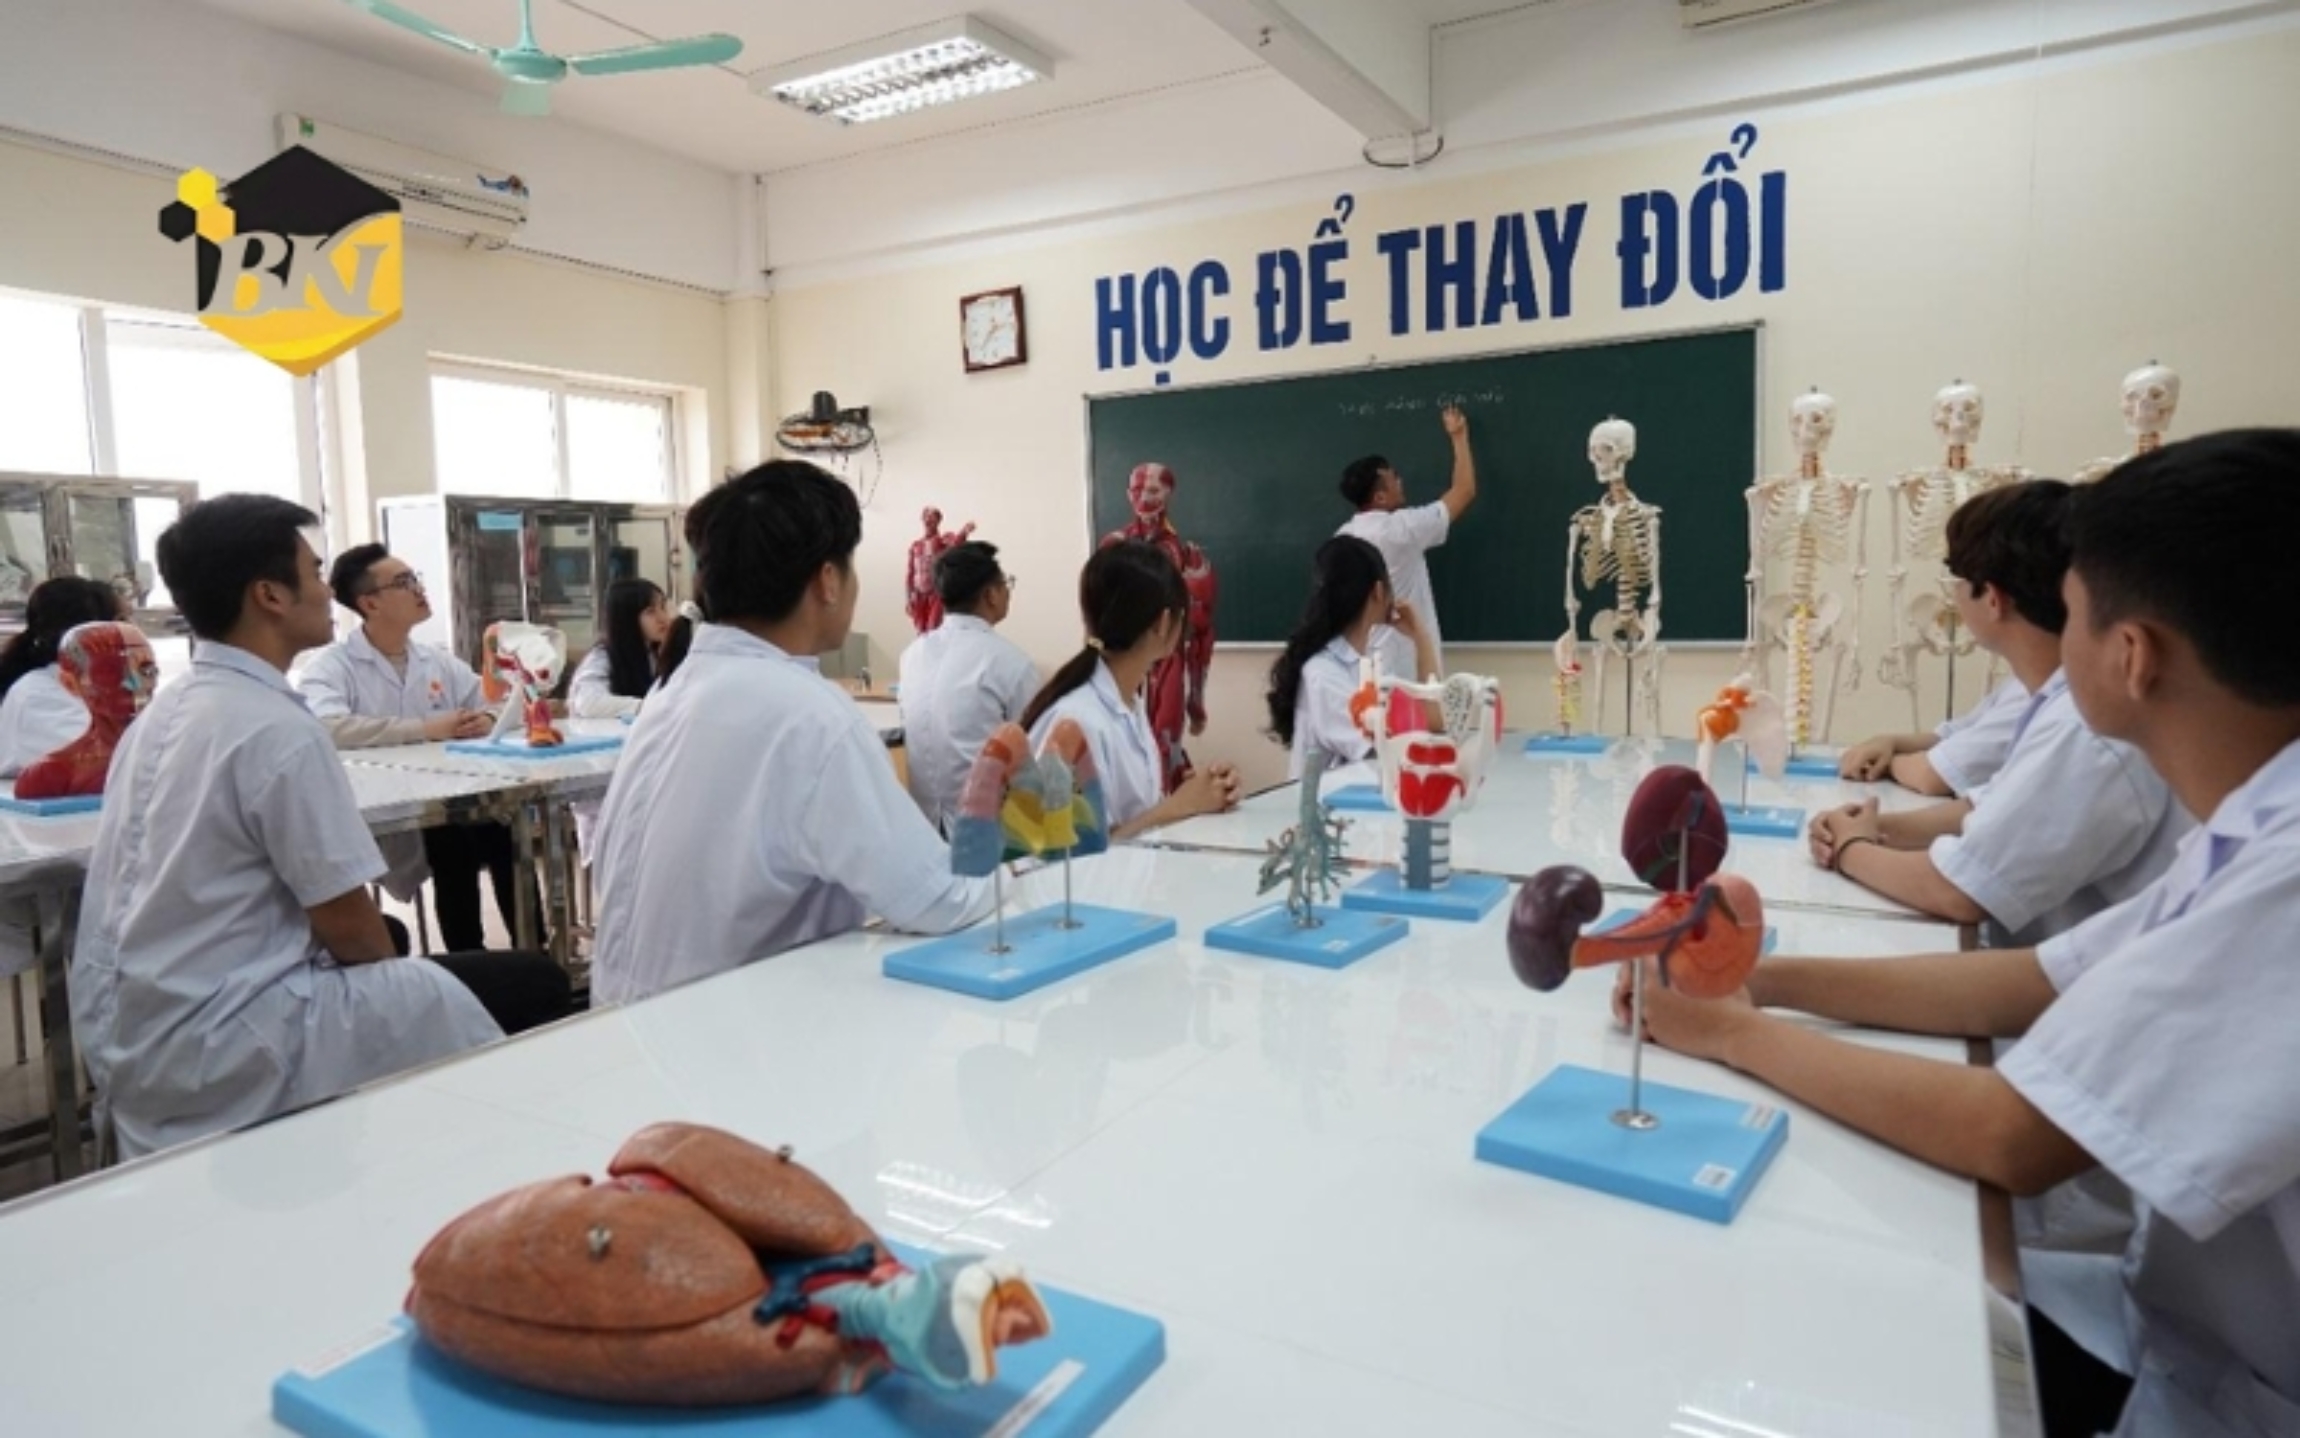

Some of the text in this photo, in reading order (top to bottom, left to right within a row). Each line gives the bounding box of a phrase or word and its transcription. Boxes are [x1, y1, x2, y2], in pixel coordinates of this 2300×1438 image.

[1095, 123, 1787, 386] HỌC ĐỂ THAY ĐỔI
